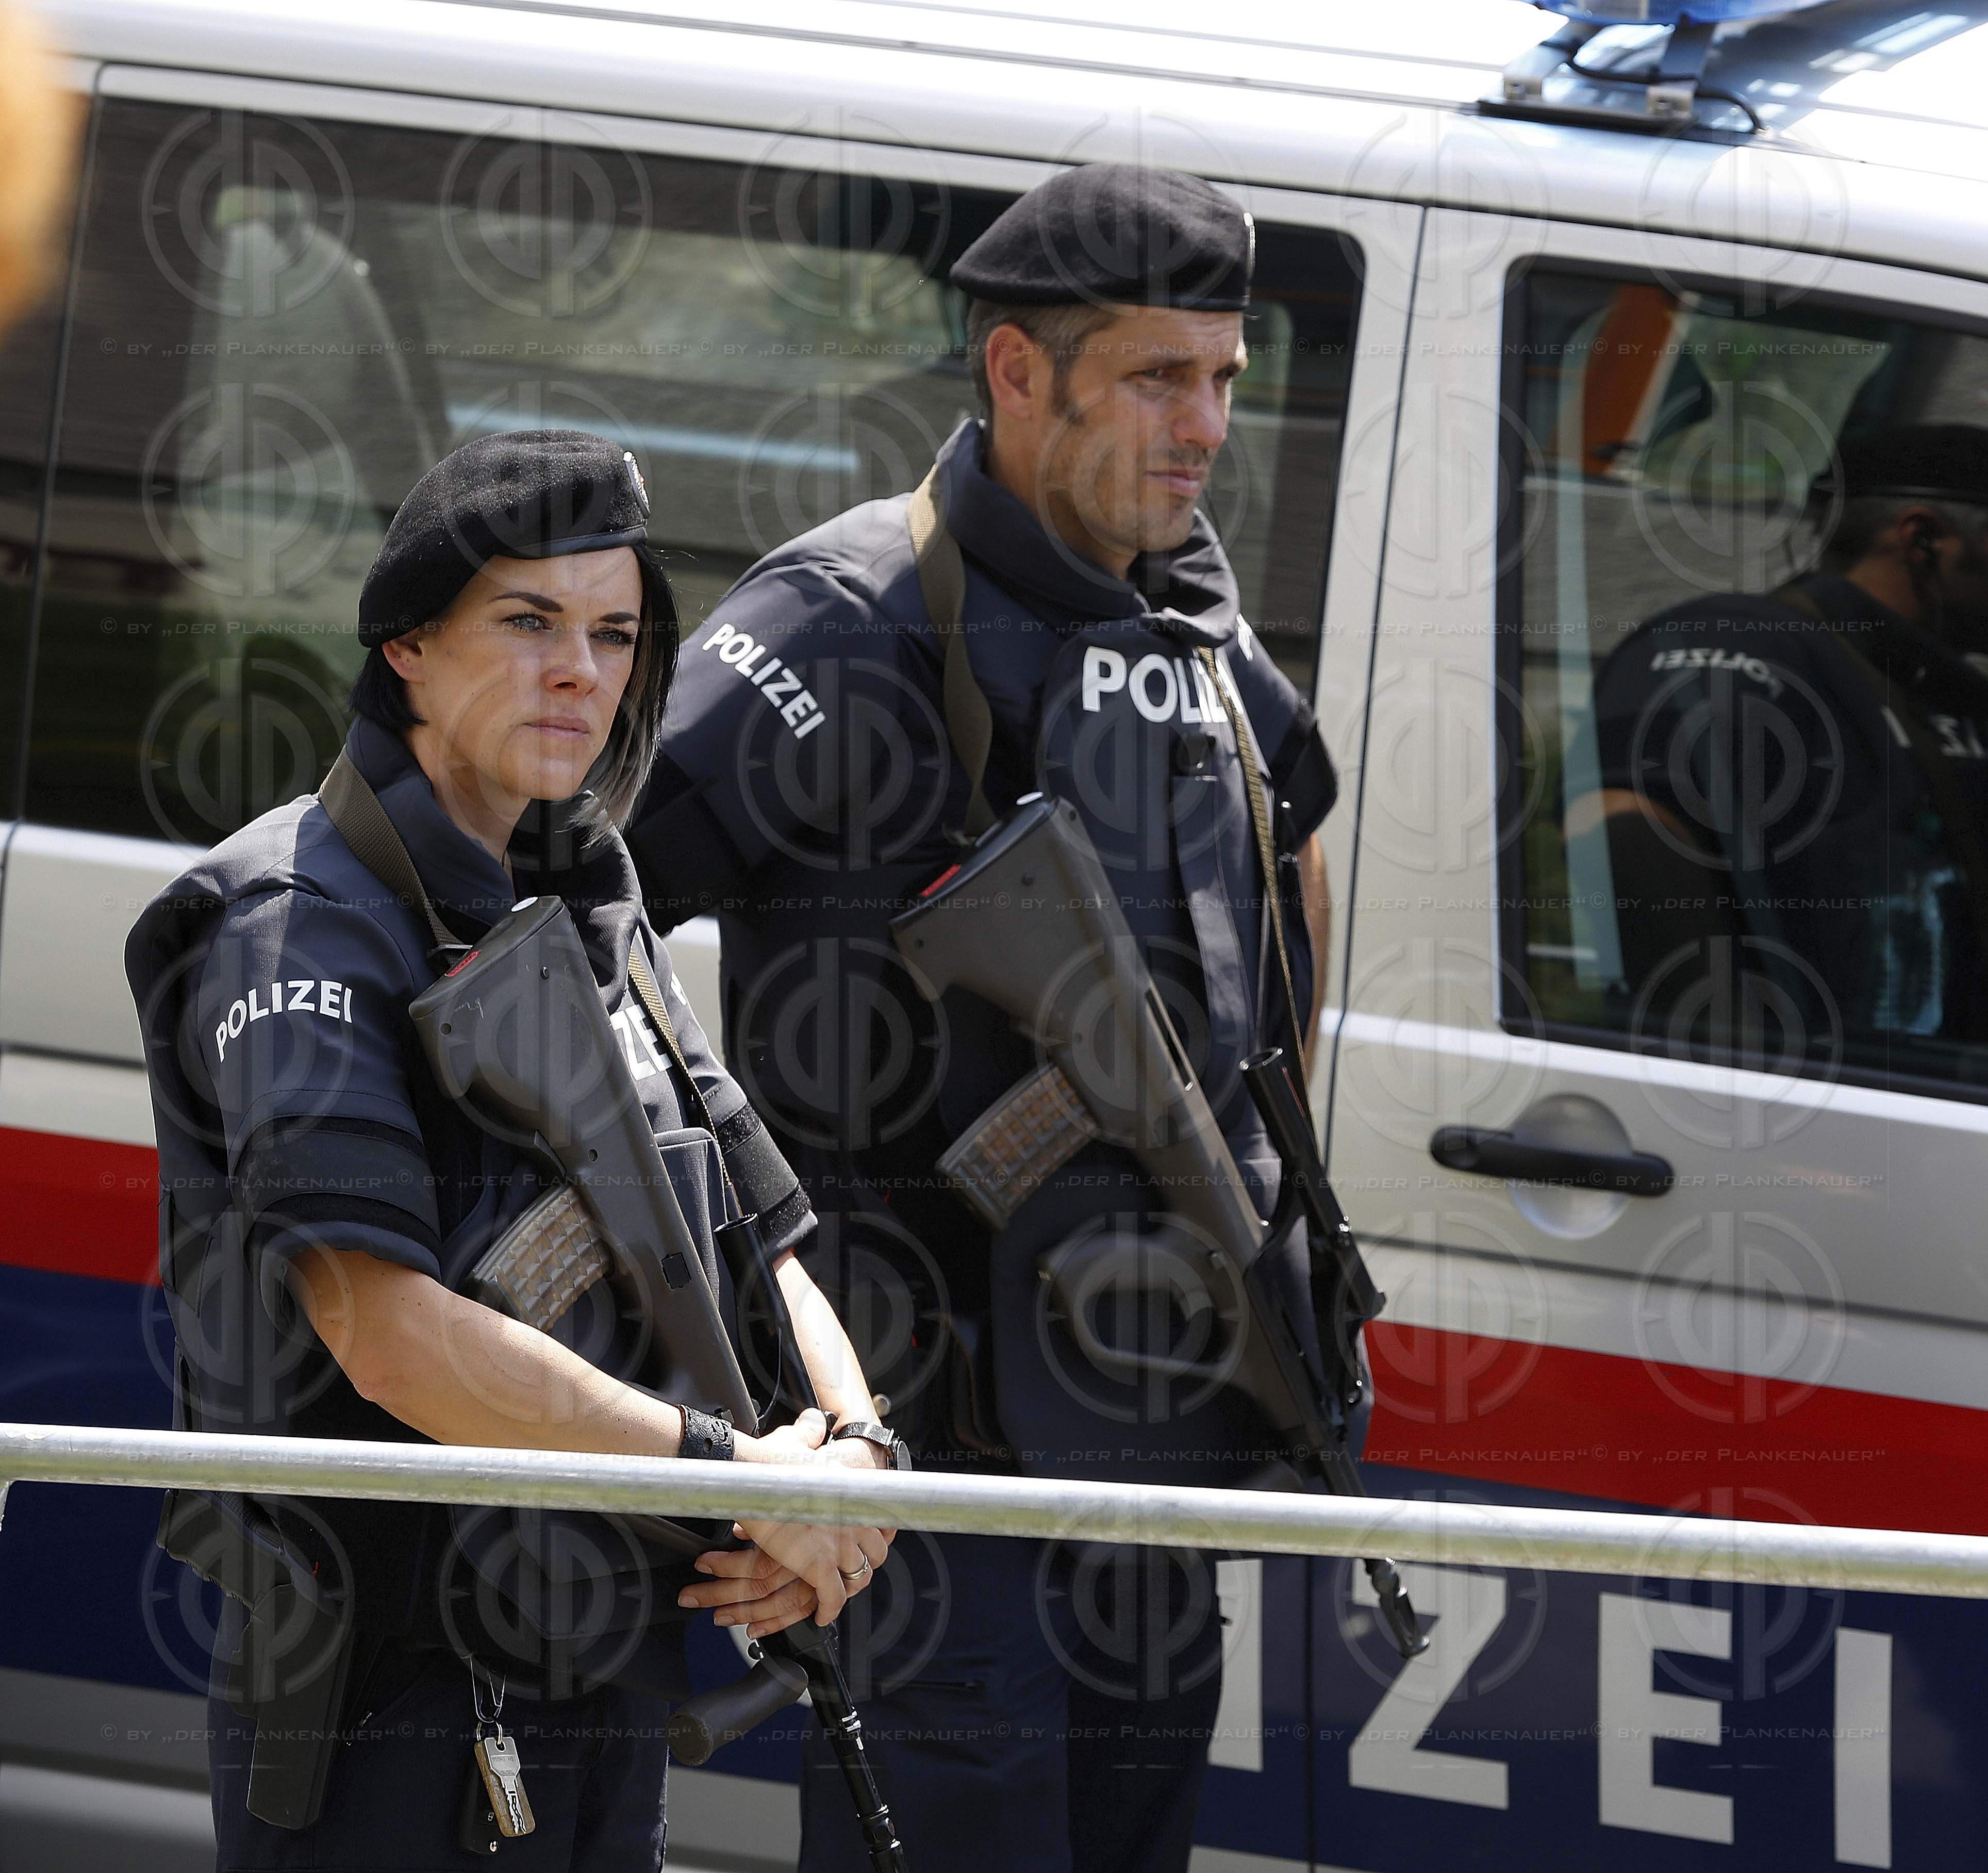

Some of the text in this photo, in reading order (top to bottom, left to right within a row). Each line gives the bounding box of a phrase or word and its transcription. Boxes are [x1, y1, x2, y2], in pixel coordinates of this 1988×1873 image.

[702, 622, 824, 739] POLIZEI
[215, 980, 353, 1063] POLIZEI
[1208, 1557, 1893, 1869] IZEI
